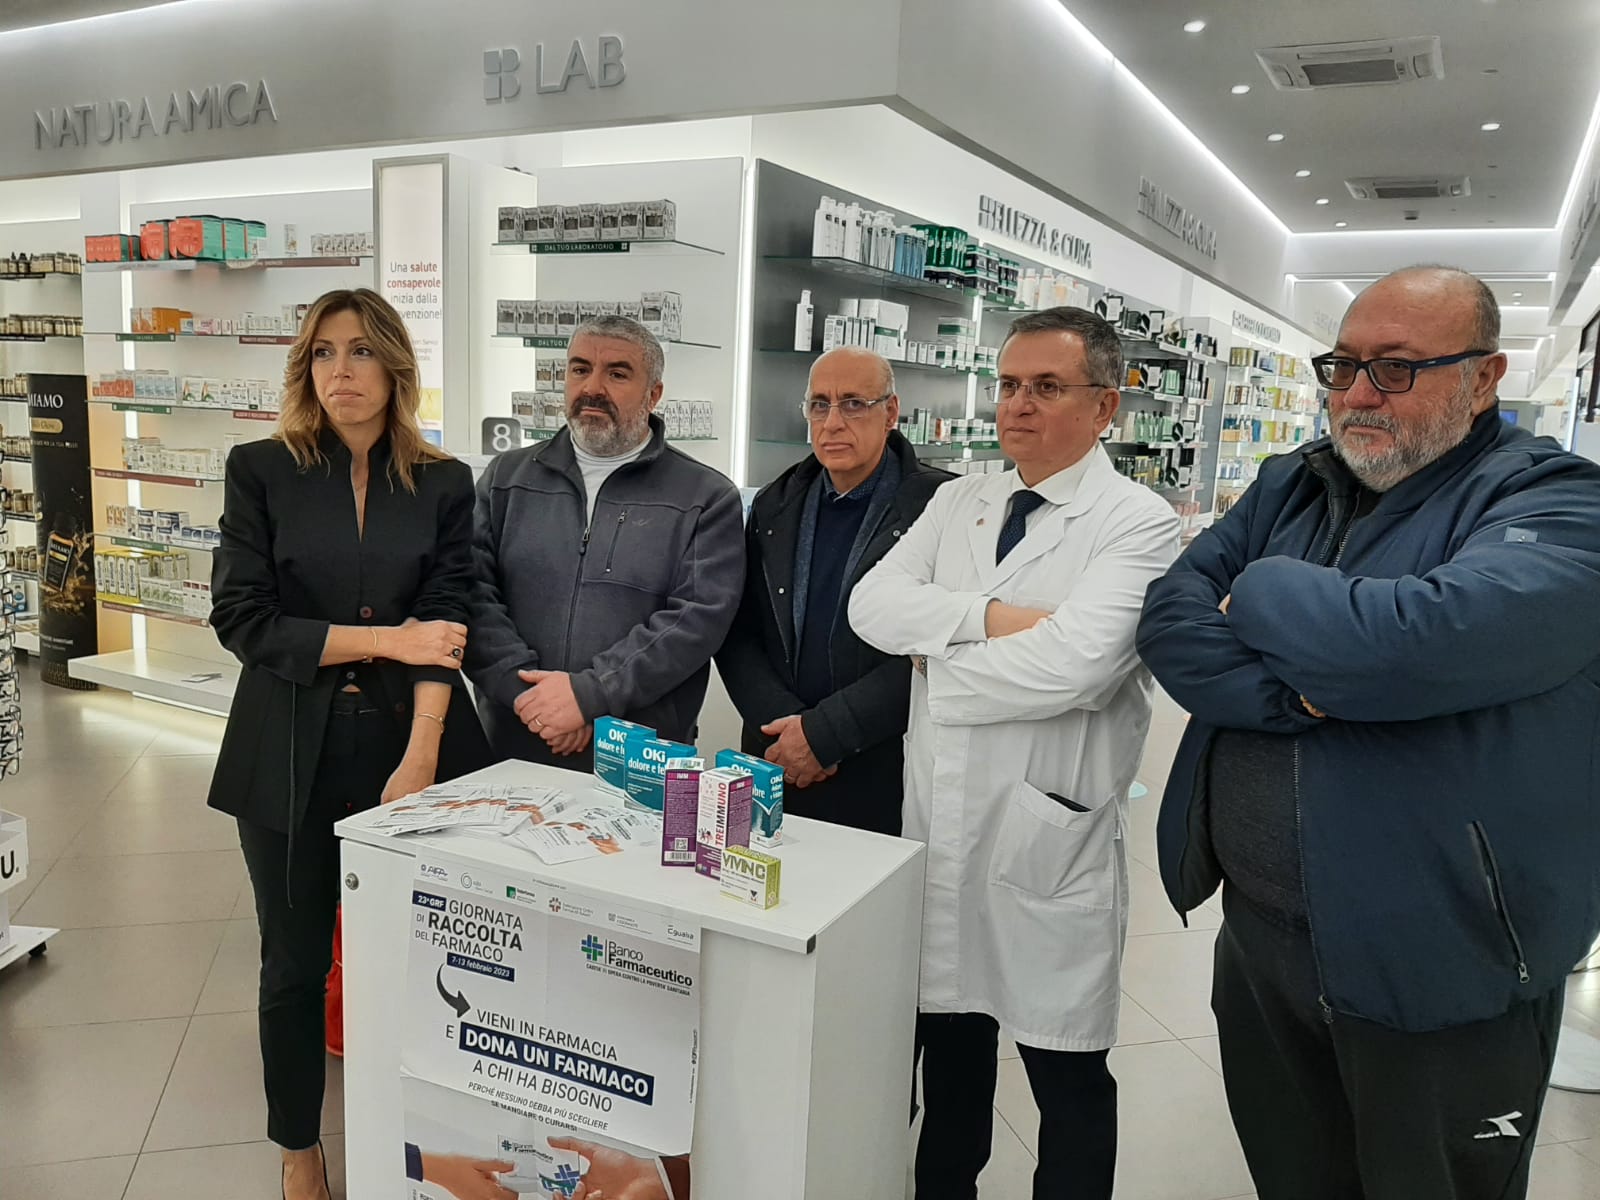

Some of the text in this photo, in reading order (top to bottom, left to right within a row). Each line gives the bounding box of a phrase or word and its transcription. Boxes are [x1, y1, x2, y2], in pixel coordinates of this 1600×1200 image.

[536, 34, 625, 94] LAB
[33, 78, 279, 150] NATURA AMICA
[1049, 228, 1061, 257] &
[1060, 232, 1093, 269] CURA
[386, 276, 441, 290] consapevole
[390, 261, 438, 273] Una salute
[391, 292, 438, 304] inizia dalla
[492, 423, 512, 452] 8
[597, 737, 615, 752] dolore
[642, 747, 666, 763] OKi
[628, 757, 650, 772] dolore
[651, 765, 656, 773] e
[715, 782, 727, 846] TREIMMUNO
[430, 898, 444, 908] GRF
[449, 900, 523, 931] GIORNATA
[415, 930, 503, 962] DEL FARMACO
[416, 912, 523, 951] DI RACCOLTA
[451, 956, 510, 977] 7-13 febbraio 2023
[609, 941, 644, 961] Banco
[609, 954, 693, 986] Farmaceutico
[477, 1009, 617, 1061] VIENI IN FARMACIA
[446, 1025, 648, 1098] E DONA UN FARMACO
[472, 1059, 612, 1112] A CHI HA BISOGNO
[468, 1081, 609, 1130] PERCHÉ NESSUNO DEBBA PIÙ SCEGLIERE
[491, 1100, 500, 1108] SE
[500, 1103, 537, 1120] MANGIARE
[545, 1118, 578, 1132] CURARSI
